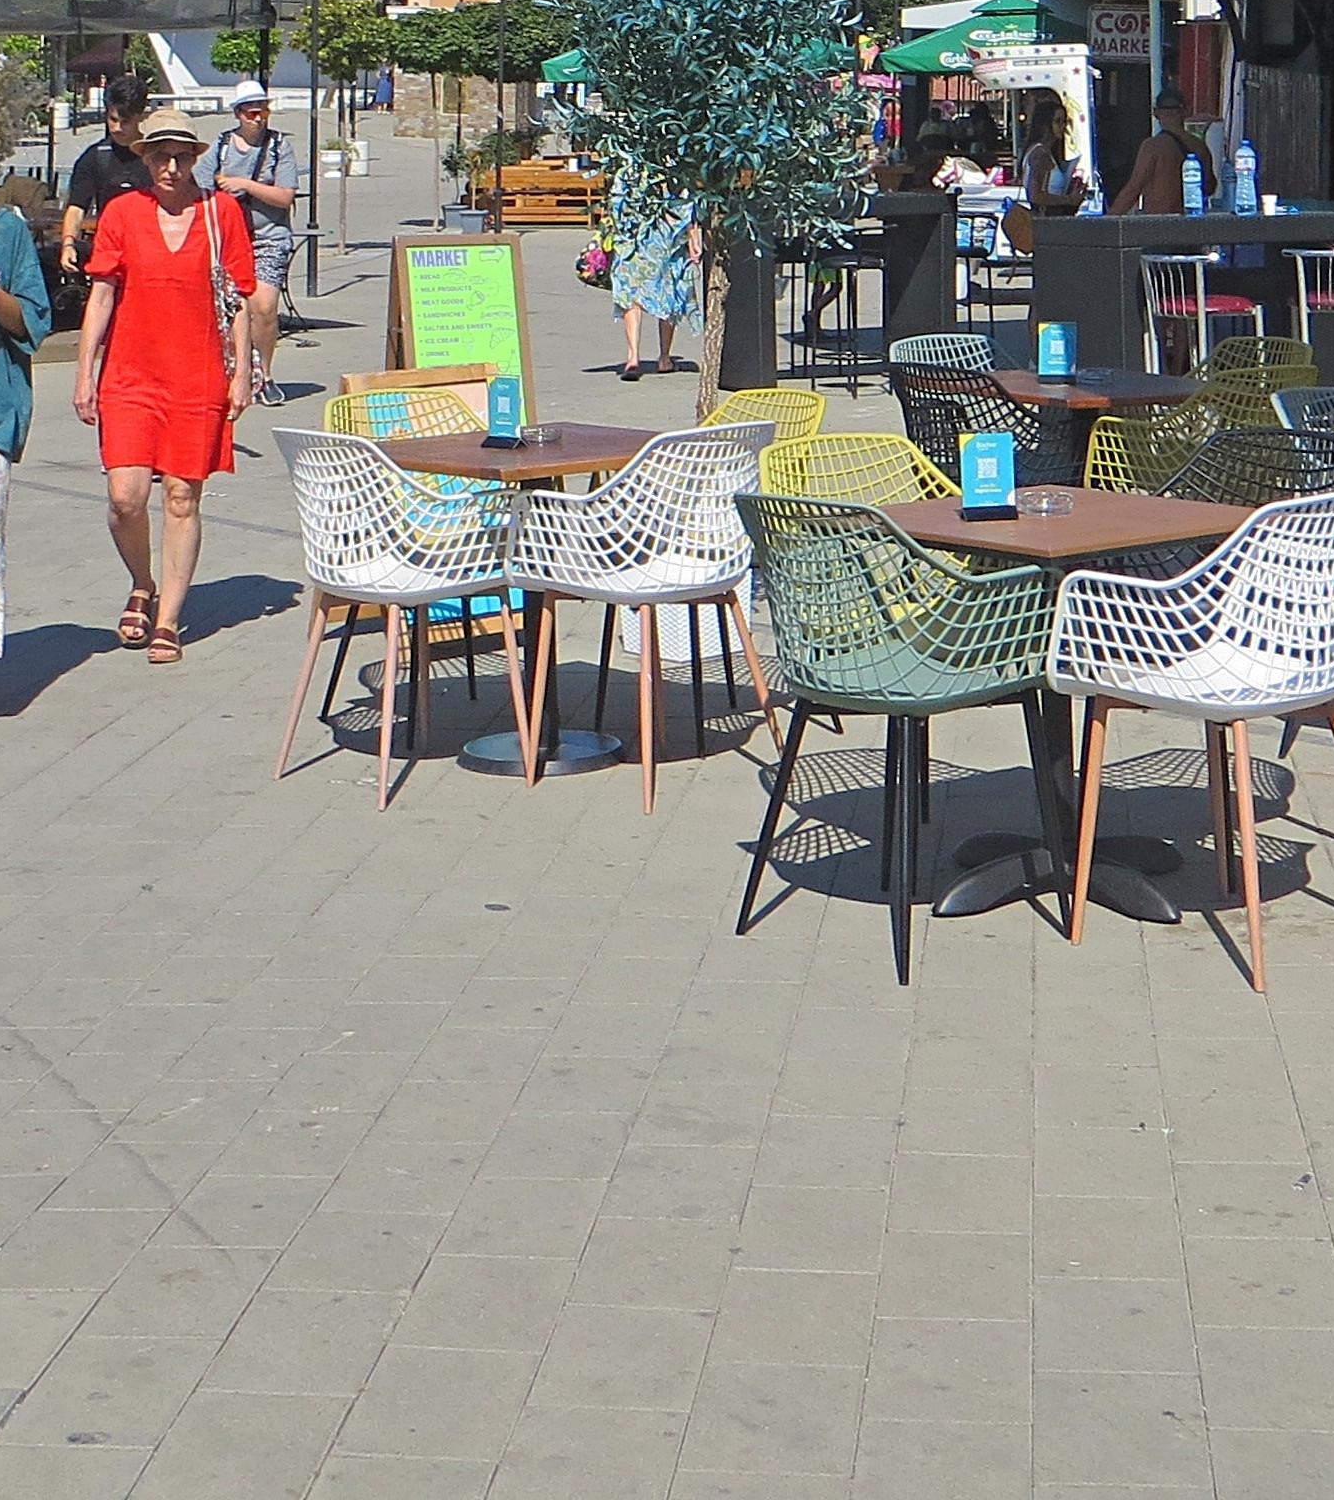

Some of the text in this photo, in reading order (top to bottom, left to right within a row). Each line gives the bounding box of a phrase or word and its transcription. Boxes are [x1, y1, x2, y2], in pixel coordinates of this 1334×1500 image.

[411, 249, 469, 267] MARKET
[422, 311, 466, 319] SANDWICHES
[466, 322, 493, 330] SWEETS
